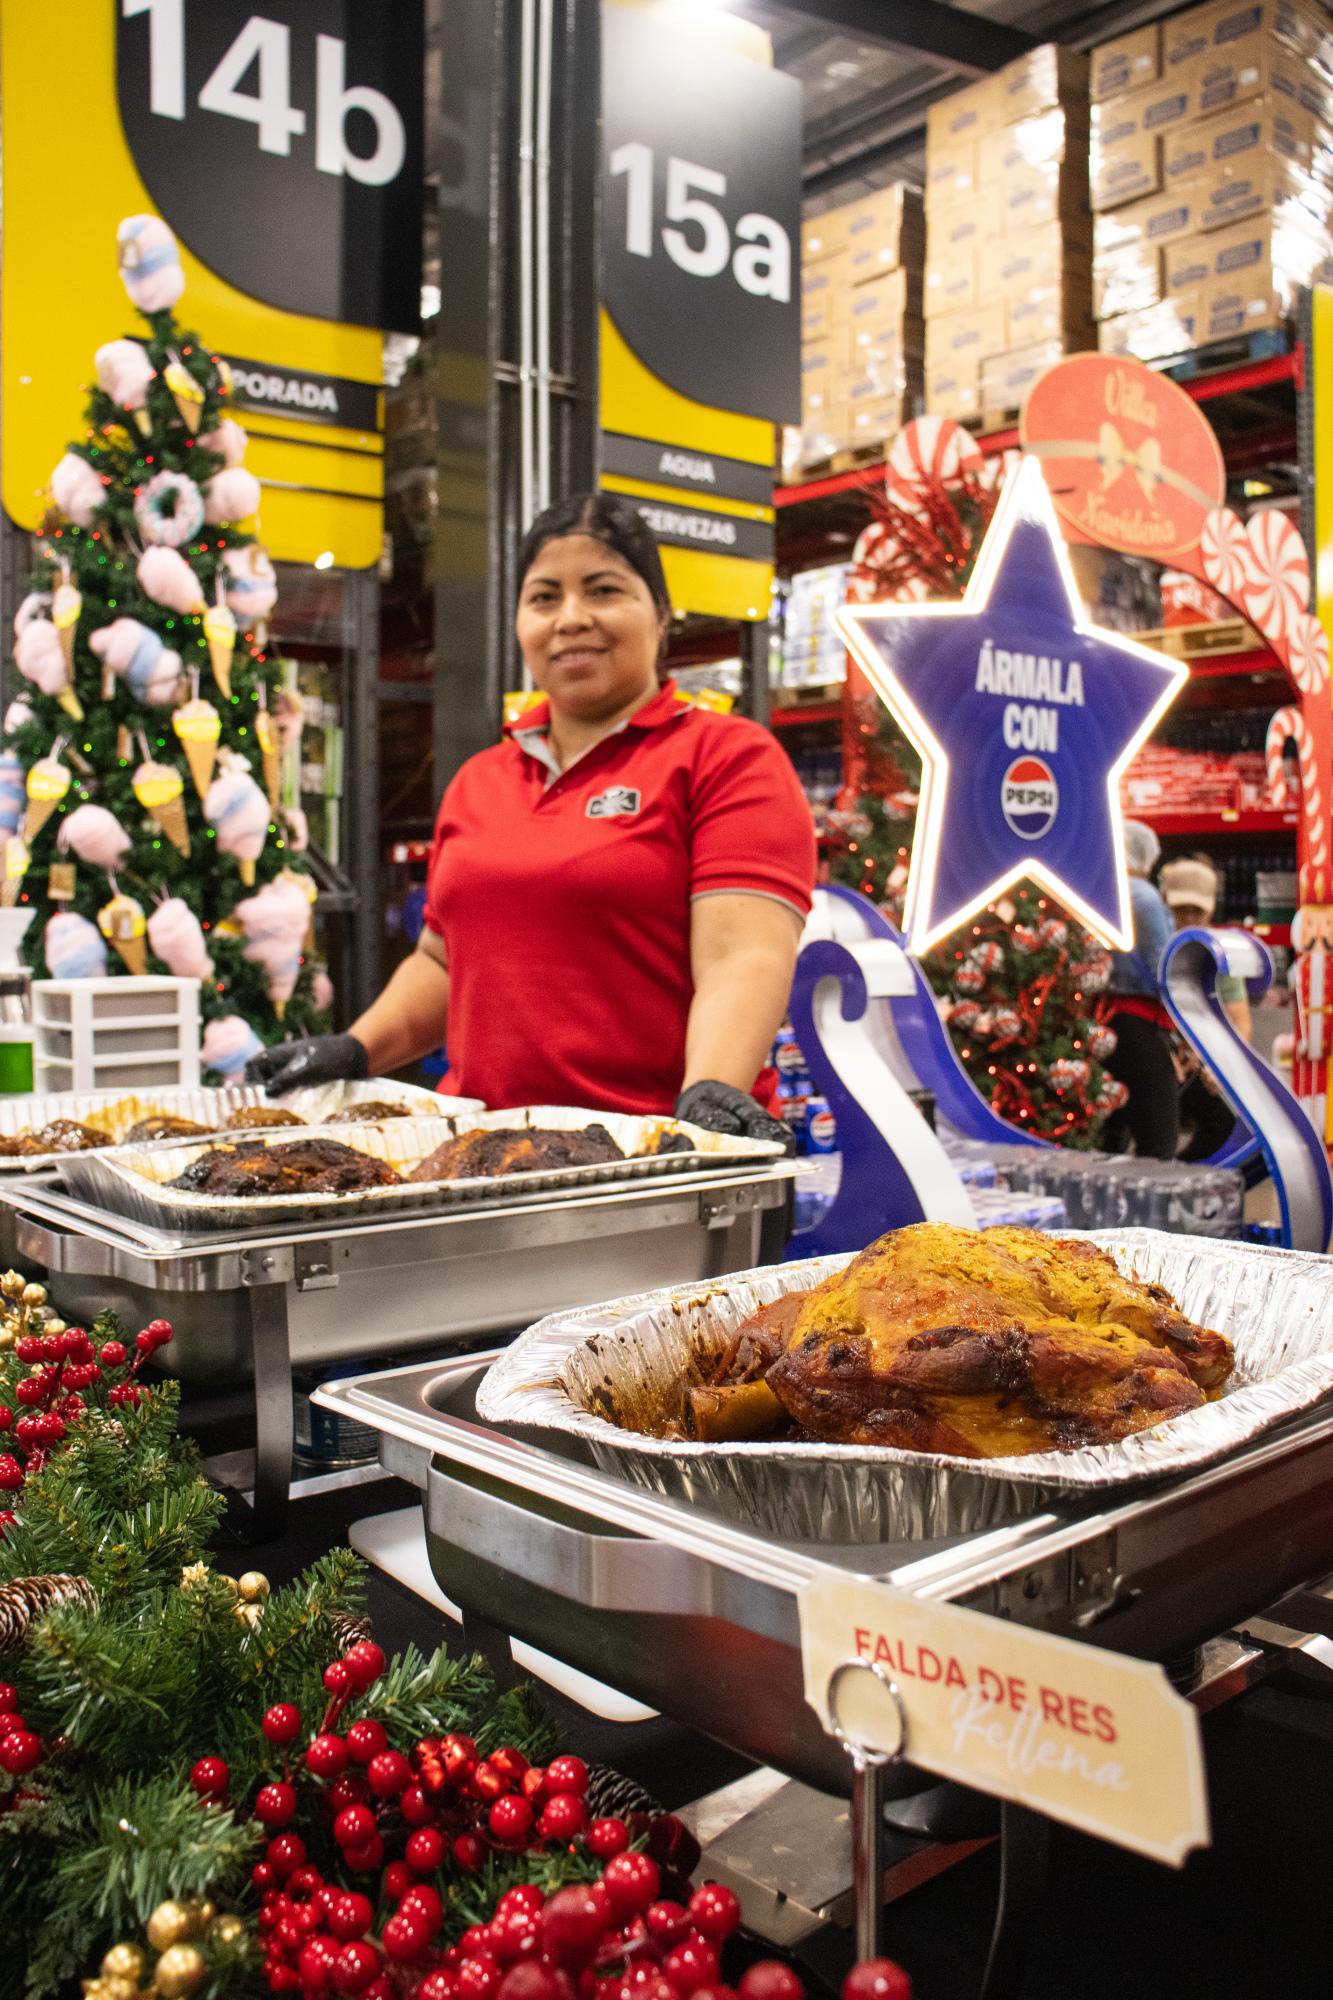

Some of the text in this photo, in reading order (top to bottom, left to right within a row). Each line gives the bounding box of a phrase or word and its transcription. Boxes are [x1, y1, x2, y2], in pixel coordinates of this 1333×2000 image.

[122, 0, 407, 187] 14b
[609, 142, 792, 305] 15a
[659, 452, 716, 484] AGUA
[975, 638, 1085, 707] ÁRMALA
[1003, 702, 1059, 753] CON
[1006, 788, 1054, 807] PEPSI
[854, 1627, 1118, 1745] FALDA DE RES
